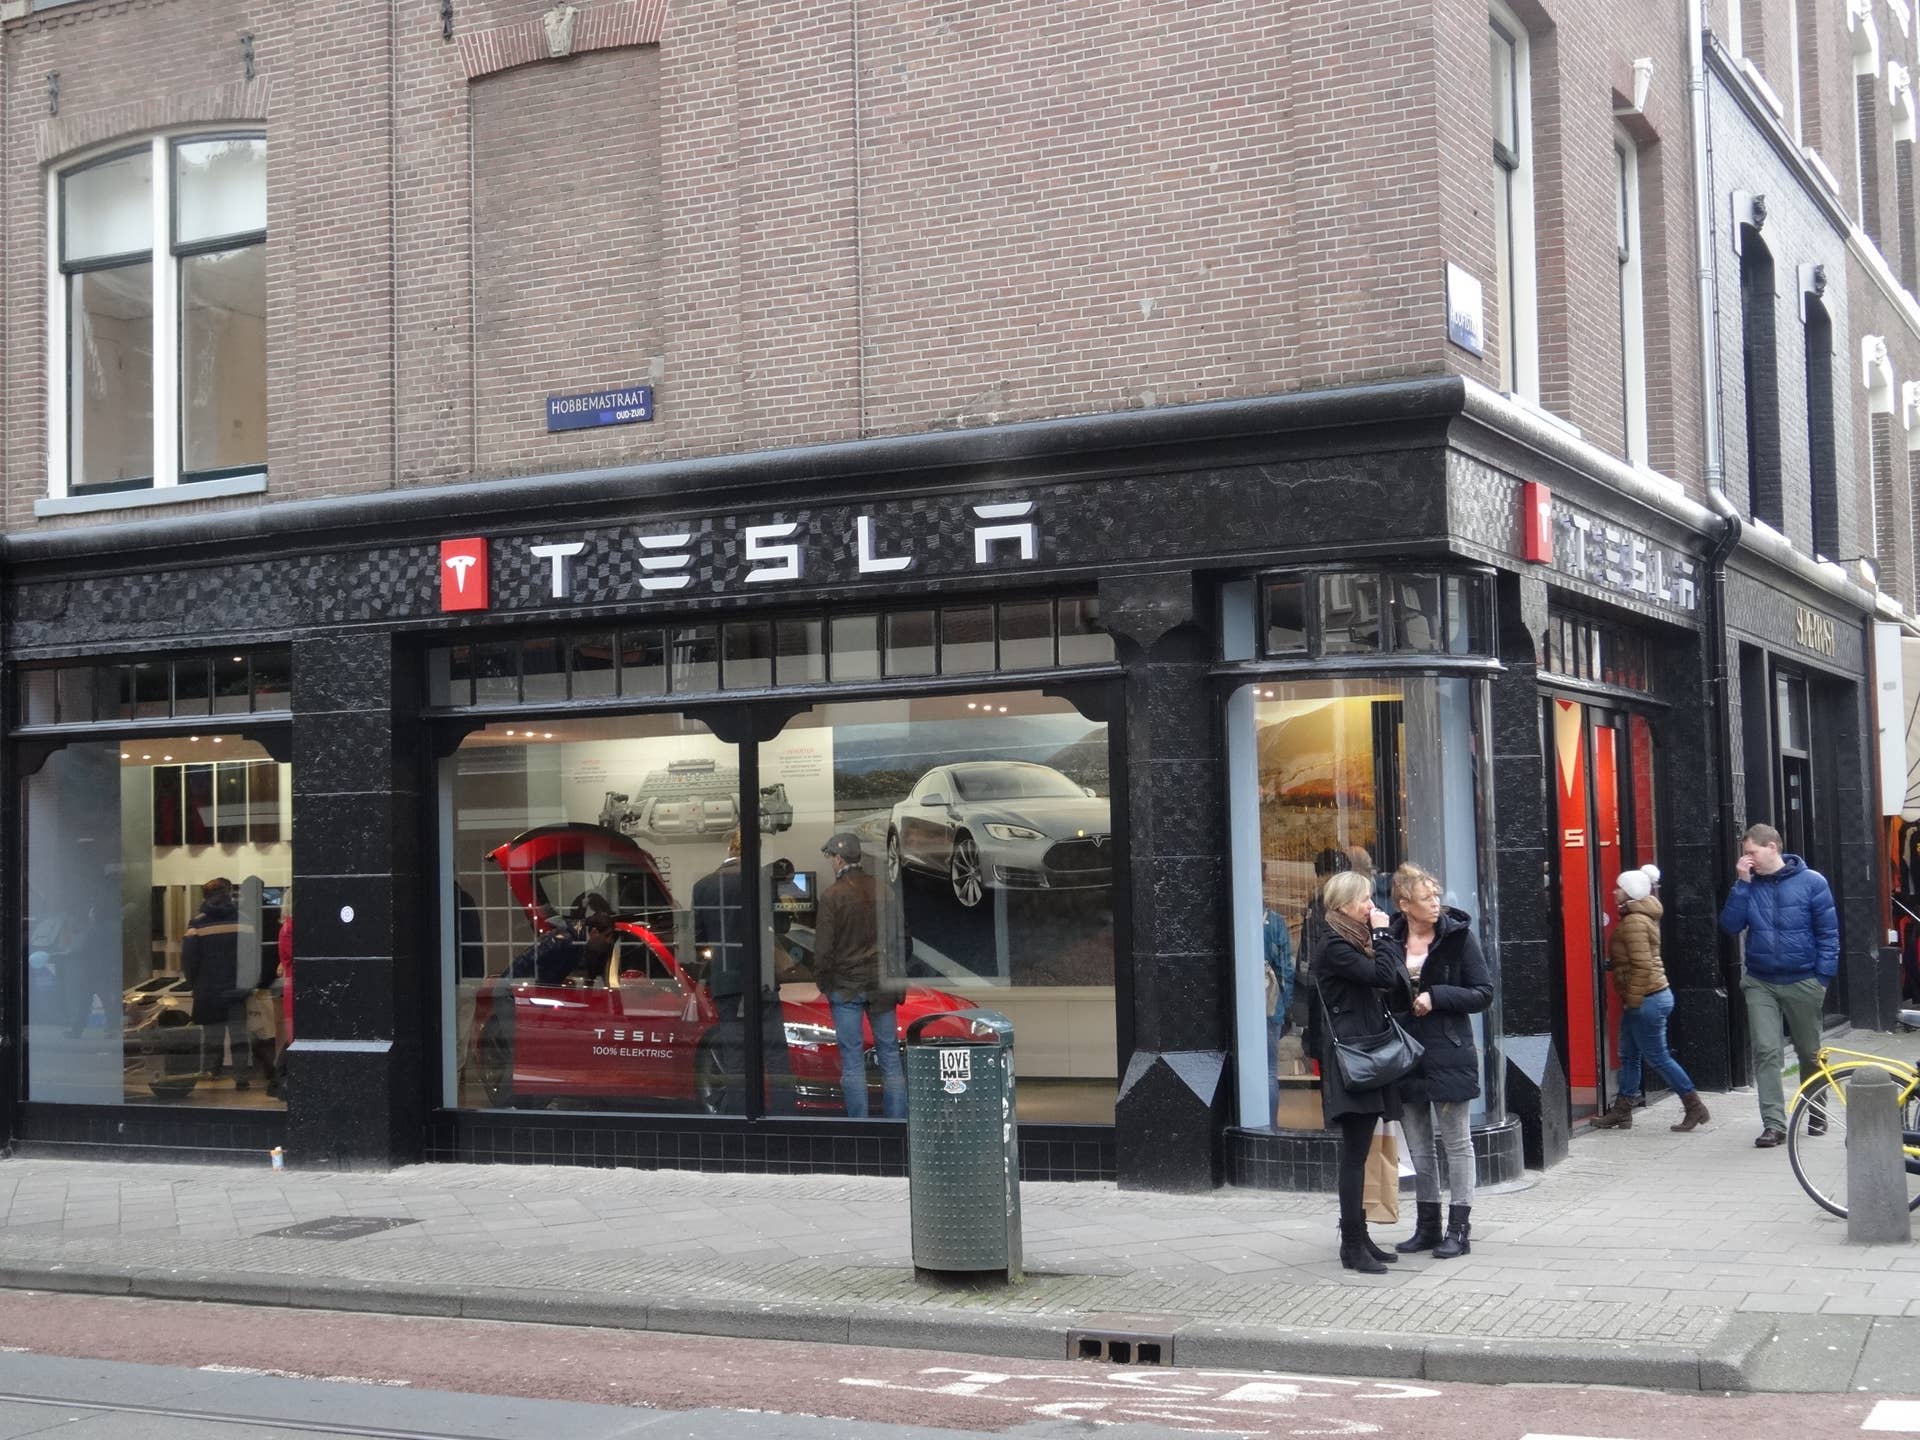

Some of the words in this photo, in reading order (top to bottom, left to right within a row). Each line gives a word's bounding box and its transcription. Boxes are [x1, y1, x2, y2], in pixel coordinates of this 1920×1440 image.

[551, 390, 644, 415] HOBBEMASTRAAT
[616, 408, 646, 420] OUD-ZUID
[530, 501, 1034, 598] TESLA
[1571, 513, 1695, 610] TESLA
[592, 1046, 618, 1056] 100%
[942, 1052, 969, 1069] LOVE
[943, 1070, 969, 1079] ME
